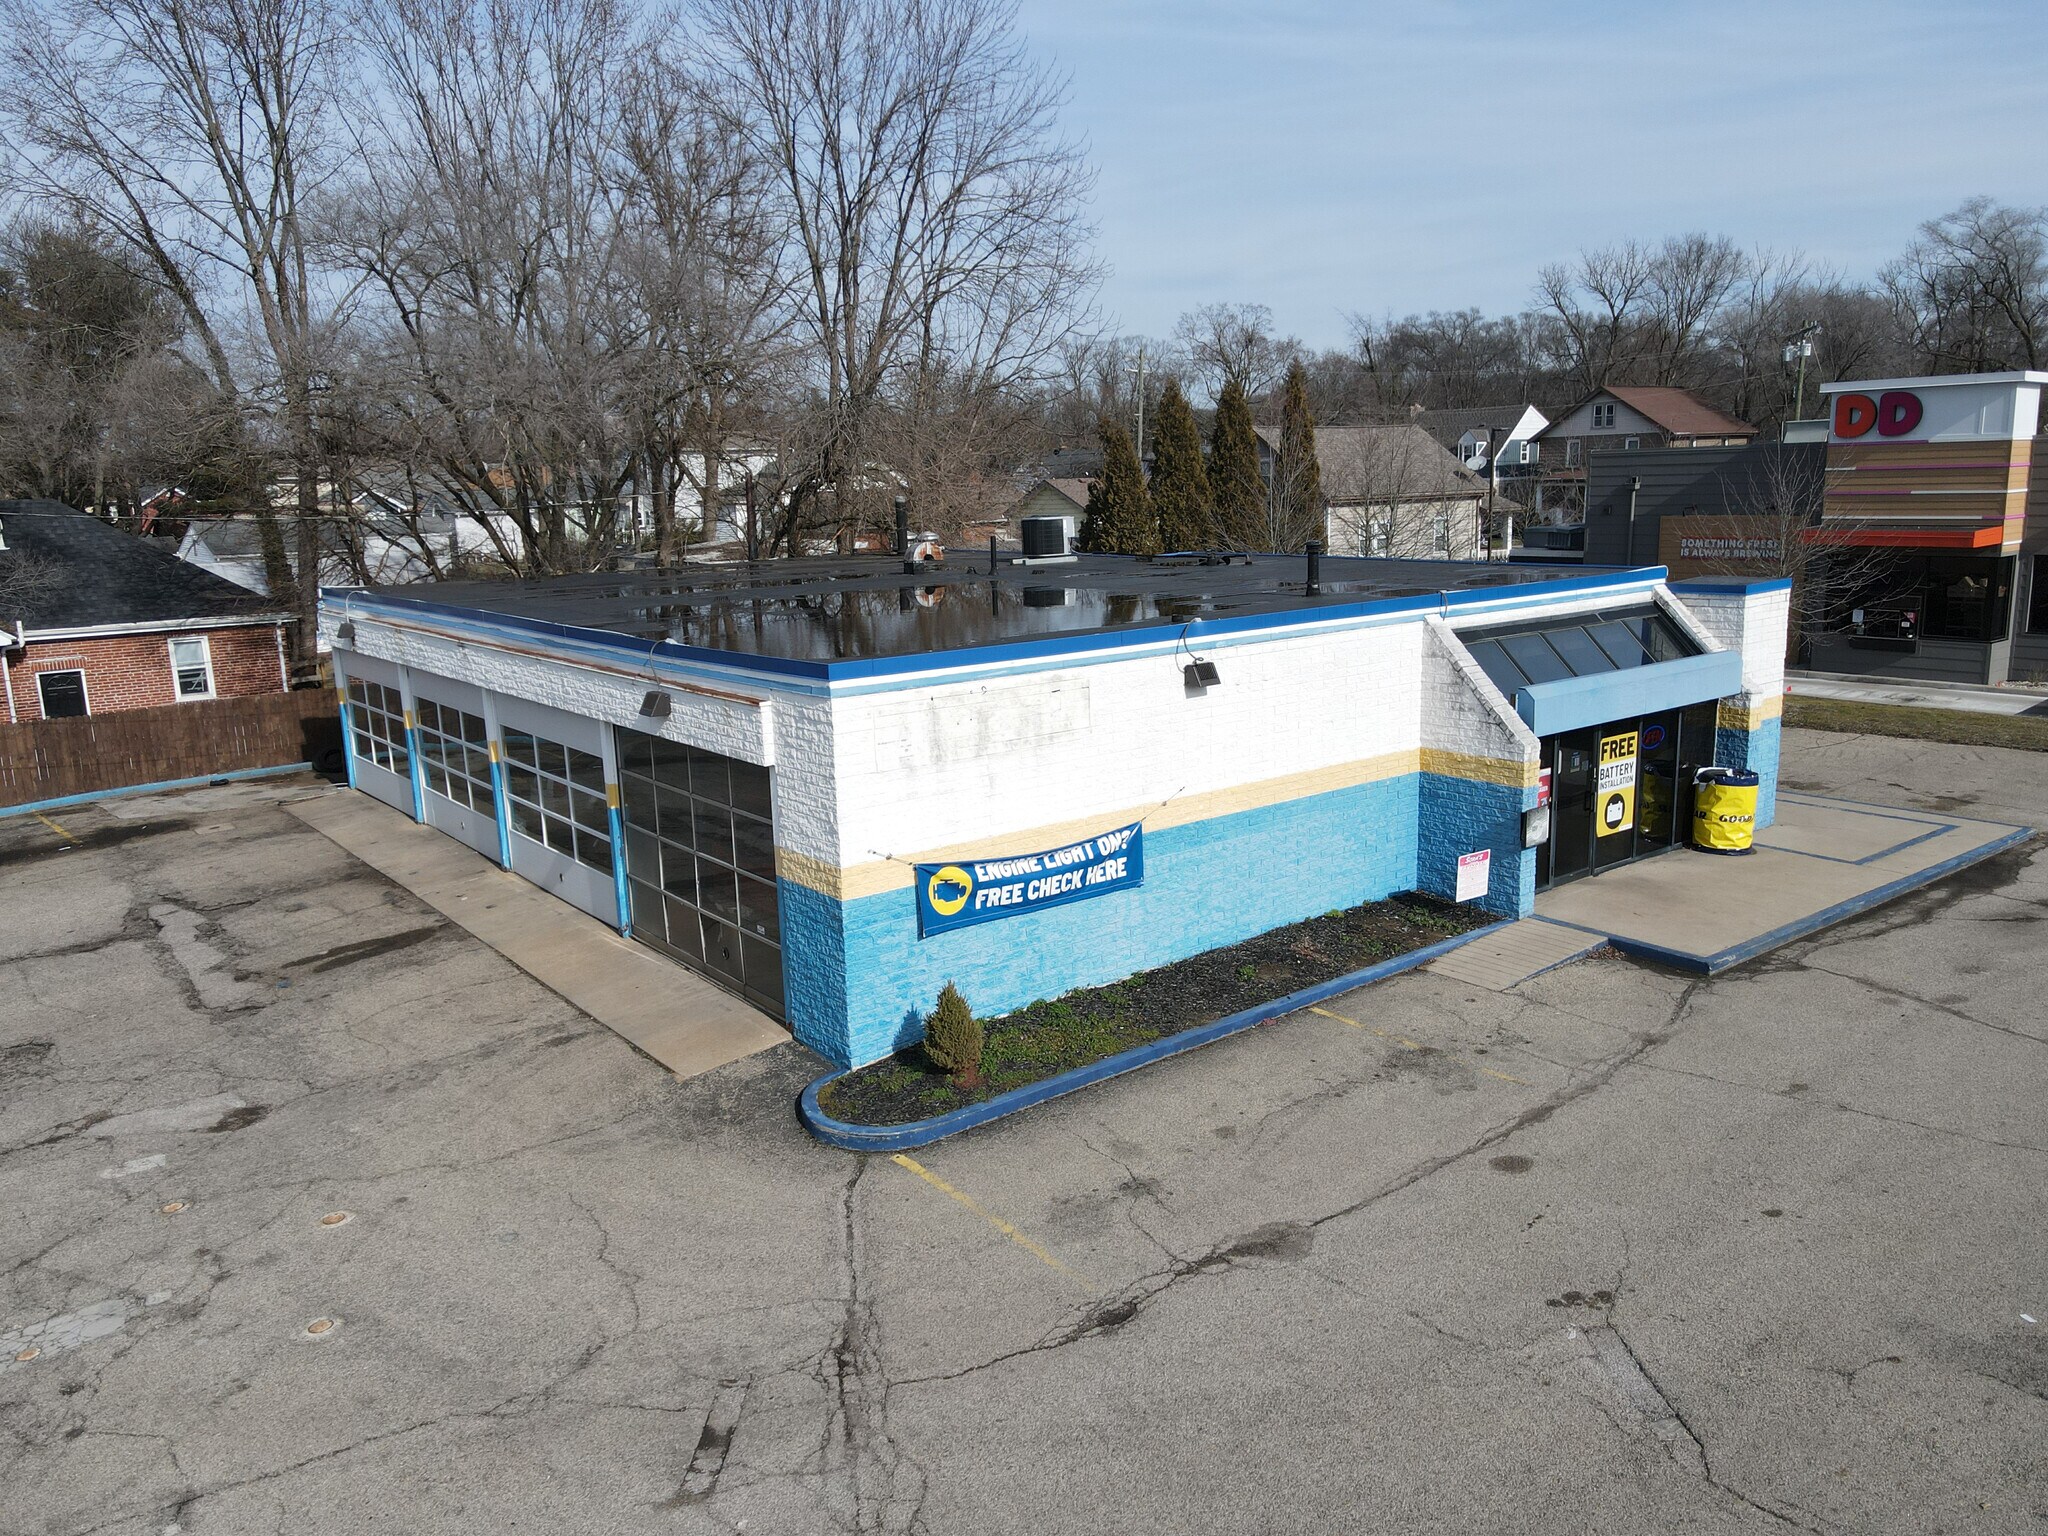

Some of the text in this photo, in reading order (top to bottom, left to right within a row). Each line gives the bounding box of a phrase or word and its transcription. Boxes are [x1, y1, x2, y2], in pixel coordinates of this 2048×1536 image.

[1835, 392, 1923, 438] DD
[1681, 539, 1744, 548] SOMETHING
[1691, 549, 1730, 557] ALWAYS
[1732, 549, 1781, 558] BREWING
[1600, 736, 1635, 762] FREE
[1599, 775, 1633, 790] INSTALLATION
[1600, 761, 1634, 781] BATTERY
[974, 830, 1132, 883] ENGINE LIGHT ON?
[975, 857, 1128, 910] FREE CHECK HERE
